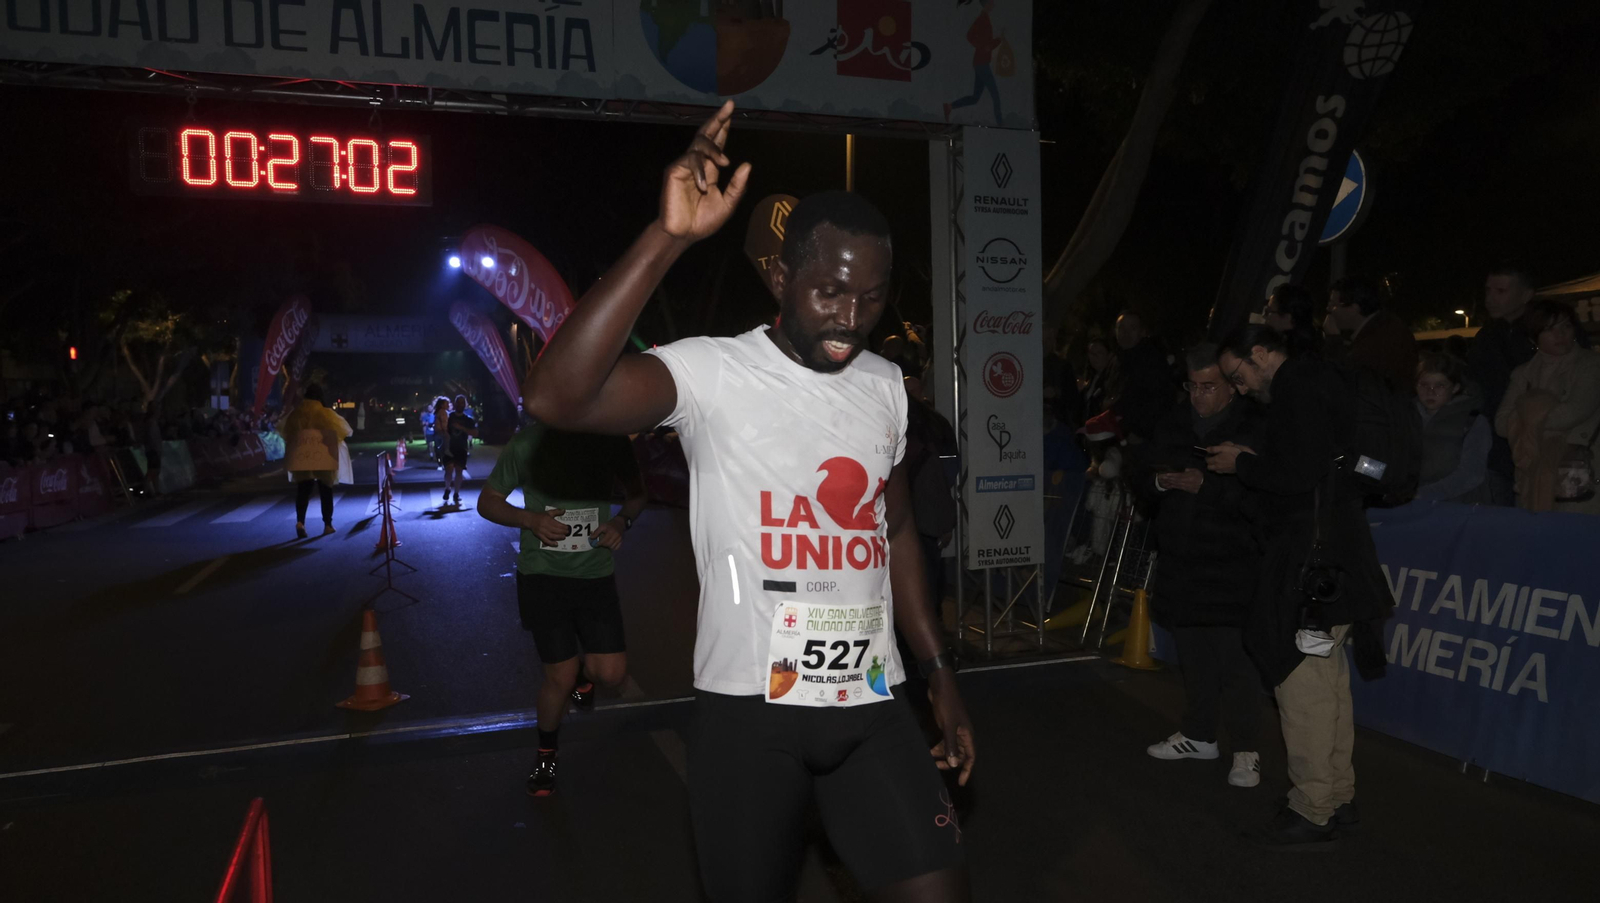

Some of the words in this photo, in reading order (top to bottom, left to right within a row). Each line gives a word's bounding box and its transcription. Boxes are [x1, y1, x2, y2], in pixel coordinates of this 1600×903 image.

[223, 0, 308, 52] DE
[329, 0, 597, 73] ALMERÍA
[180, 128, 418, 195] 00:27:02
[974, 195, 1029, 207] RENAULT
[974, 206, 992, 214] SYRSA
[976, 256, 1027, 265] NISSAN
[973, 309, 1036, 335] Coca-Cola
[978, 478, 1017, 491] Almericar
[760, 490, 821, 529] LA
[760, 532, 887, 571] UNION
[977, 546, 1031, 558] RENAULT
[977, 558, 995, 567] SYRSA
[995, 556, 1031, 565] AUTOMOCION
[806, 581, 840, 592] CORP.
[808, 607, 826, 619] XIV
[827, 608, 848, 620] SAN
[806, 619, 843, 632] CIUDAD
[844, 620, 857, 632] DE
[801, 638, 870, 670] 527
[1385, 623, 1549, 704] MERÍA
